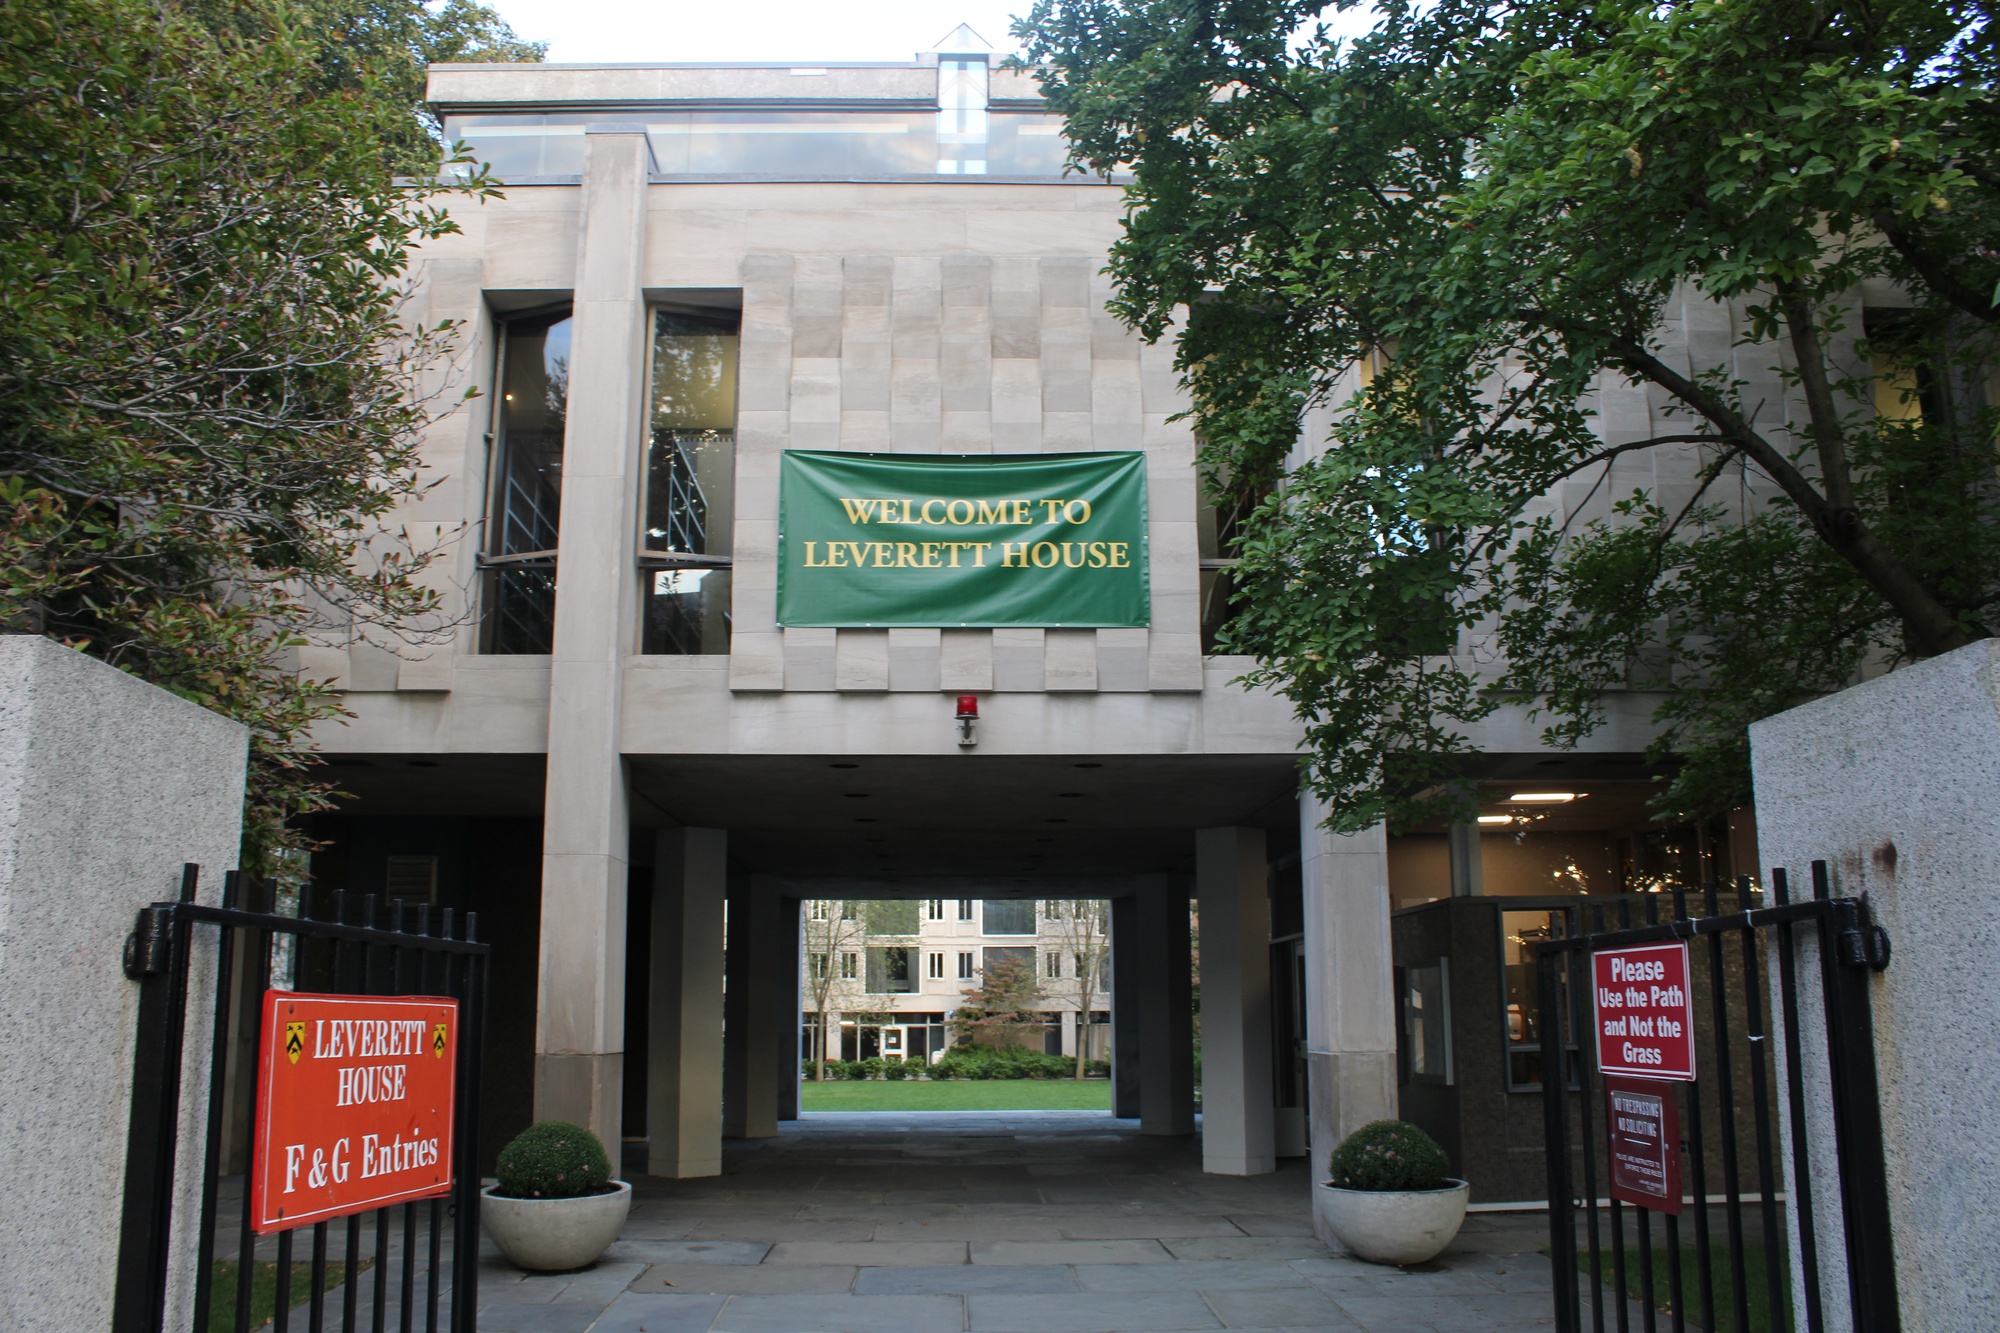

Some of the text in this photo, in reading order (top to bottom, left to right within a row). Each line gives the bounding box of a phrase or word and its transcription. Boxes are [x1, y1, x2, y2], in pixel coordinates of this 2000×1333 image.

[839, 497, 1092, 525] WELCOME TO
[803, 541, 1131, 568] LEVERETT HOUSE
[1610, 957, 1665, 982] Please
[1599, 985, 1684, 1008] Use the Path
[313, 1019, 426, 1059] LEVERETT
[1604, 1015, 1681, 1038] and Not the
[1622, 1041, 1662, 1065] Grass
[336, 1064, 406, 1107] HOUSE
[1622, 1098, 1659, 1118] TRESPASSING
[360, 1127, 438, 1179] Entries
